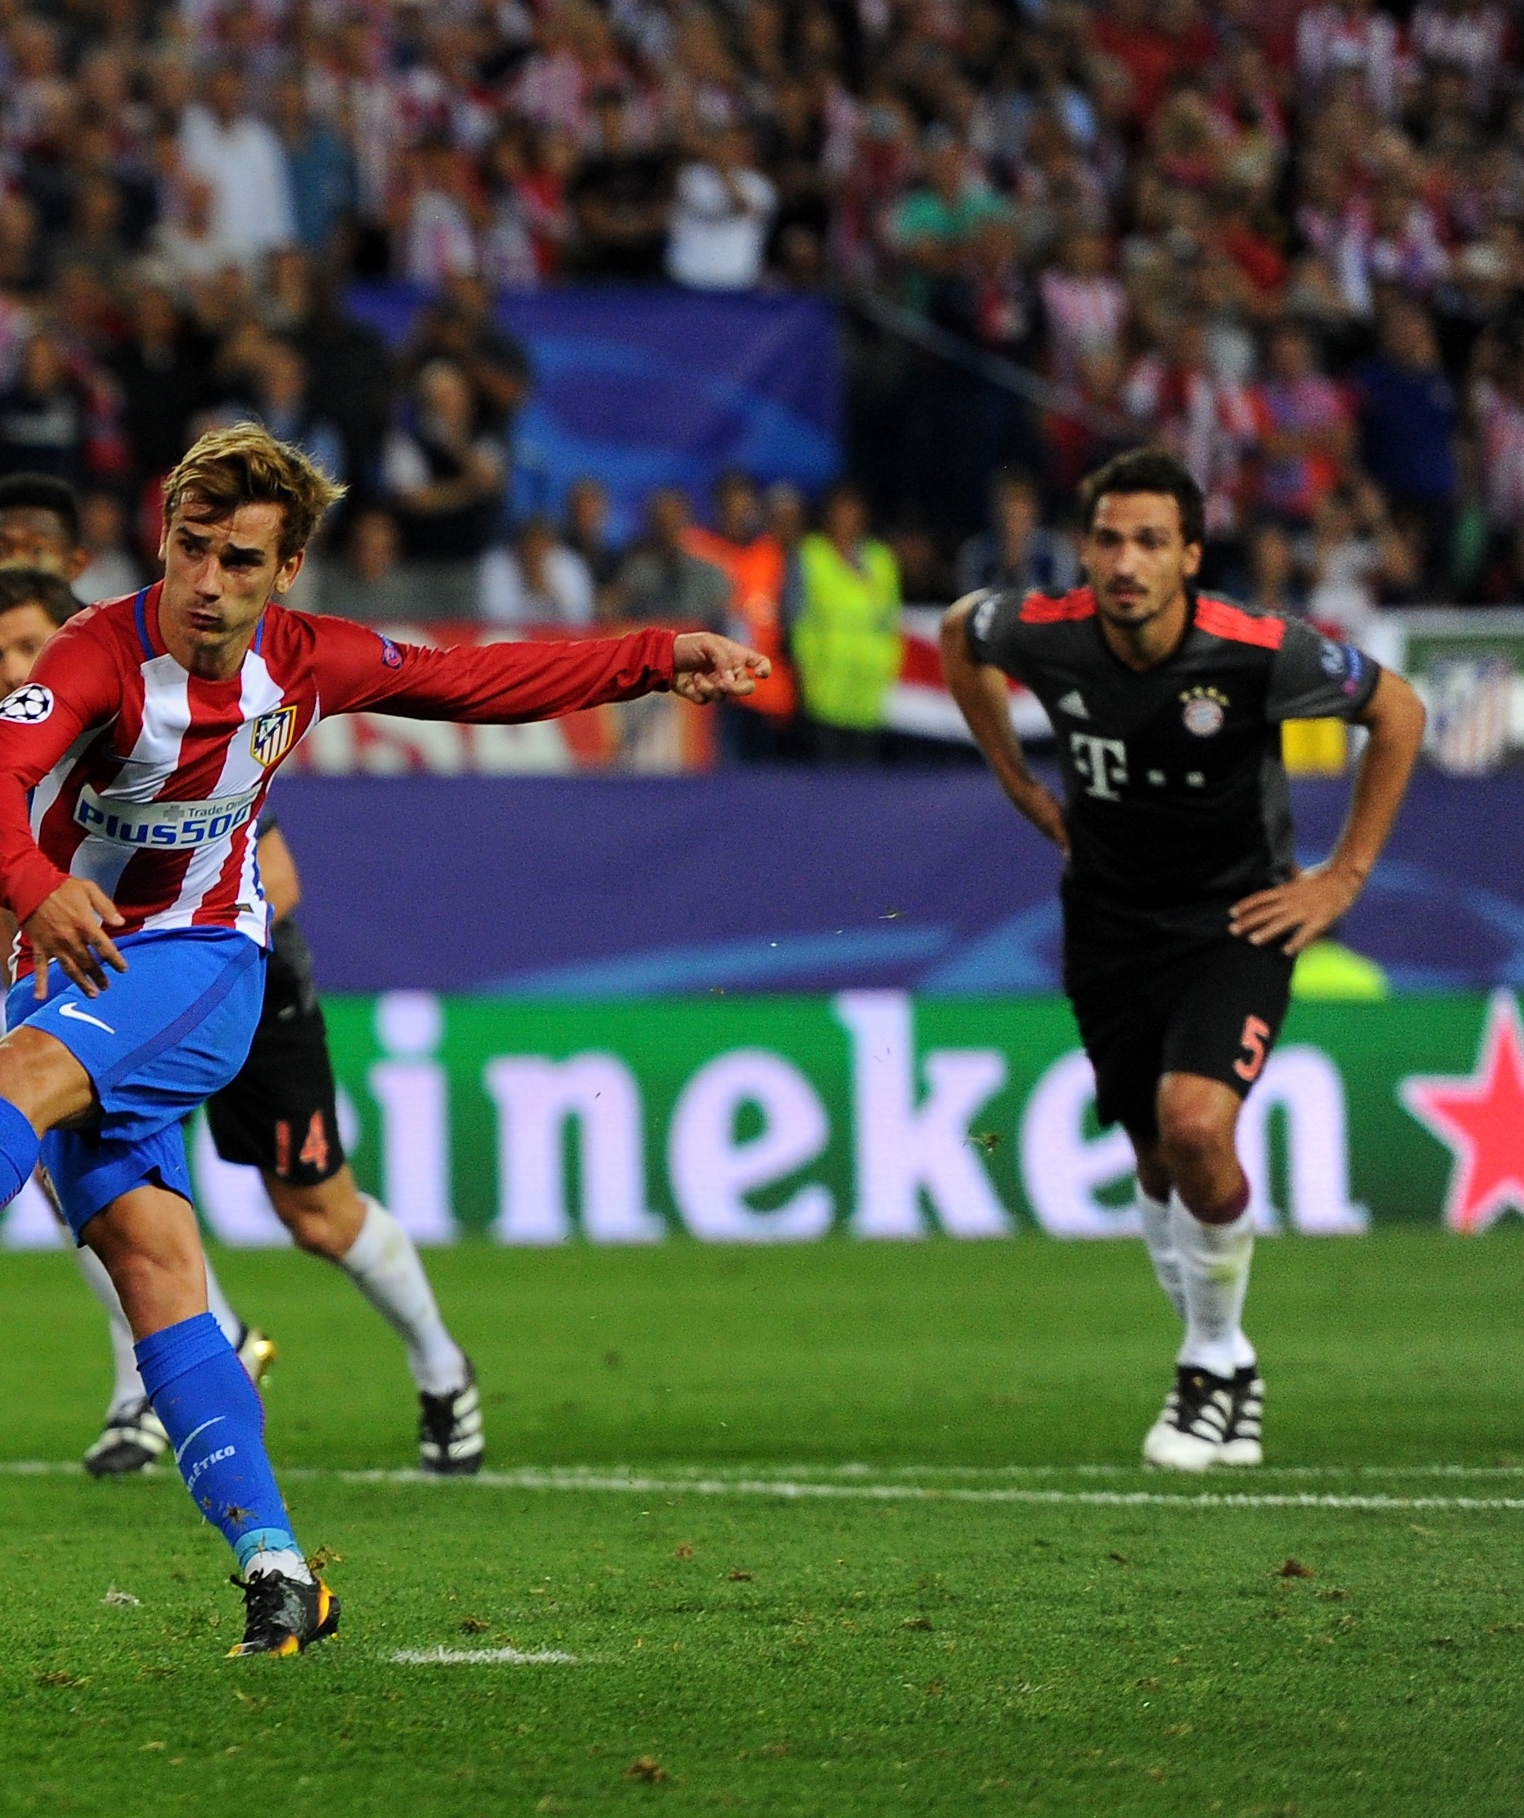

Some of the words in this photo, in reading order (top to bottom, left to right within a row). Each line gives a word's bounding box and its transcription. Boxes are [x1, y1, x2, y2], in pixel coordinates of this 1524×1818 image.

[78, 799, 252, 844] Plus500
[188, 805, 223, 818] Trade
[1233, 1015, 1270, 1082] 5
[276, 1109, 329, 1176] 14
[187, 1445, 236, 1492] TLÉTICO
